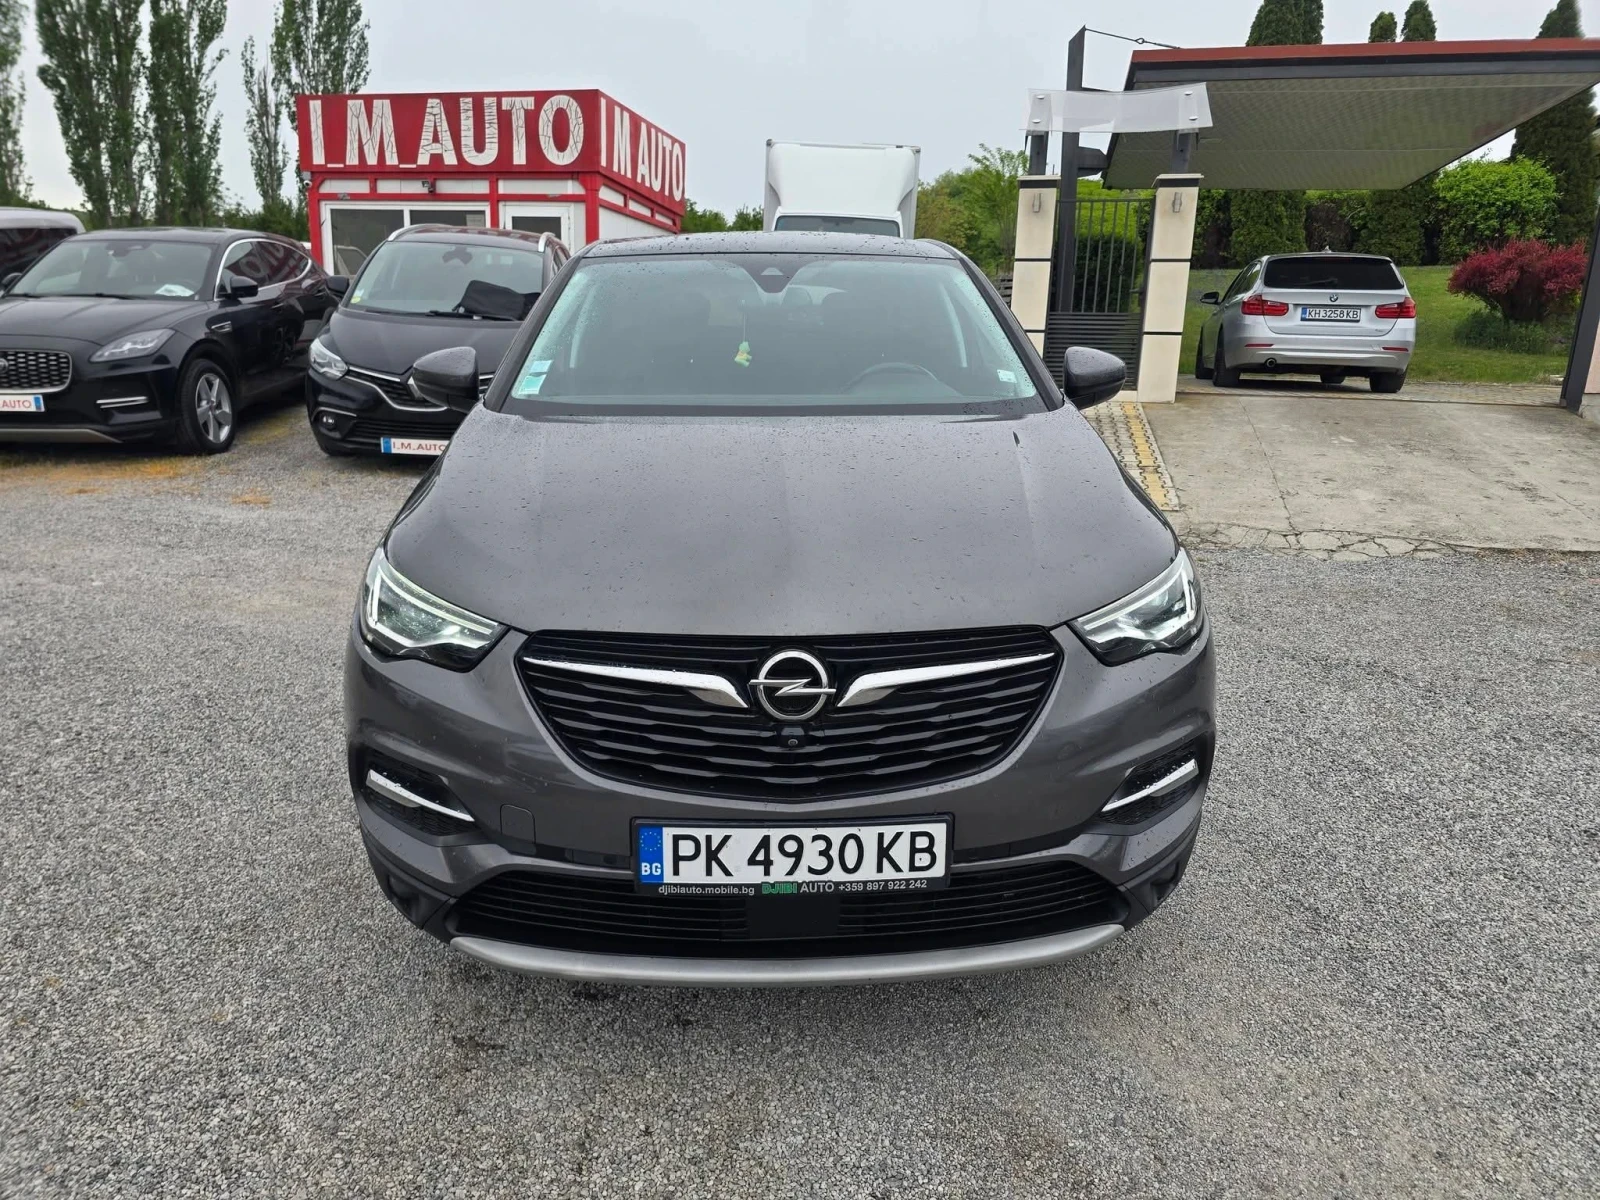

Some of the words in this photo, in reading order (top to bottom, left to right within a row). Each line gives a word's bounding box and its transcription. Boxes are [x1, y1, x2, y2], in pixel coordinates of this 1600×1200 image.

[637, 121, 683, 202] AUTO
[1308, 309, 1321, 318] KH
[1322, 309, 1345, 319] 3258
[1346, 310, 1359, 319] KB
[2, 400, 31, 408] AUTO
[671, 834, 733, 877] PK
[747, 833, 864, 877] 4930
[876, 830, 937, 875] KB
[641, 862, 661, 876] BG
[658, 885, 755, 896] djibiauto.mobile.bg
[761, 882, 798, 894] DJIBI
[800, 882, 834, 893] AUTO
[839, 882, 864, 892] +359
[866, 881, 885, 891] 897
[887, 880, 906, 890] 922
[908, 879, 927, 889] 242
